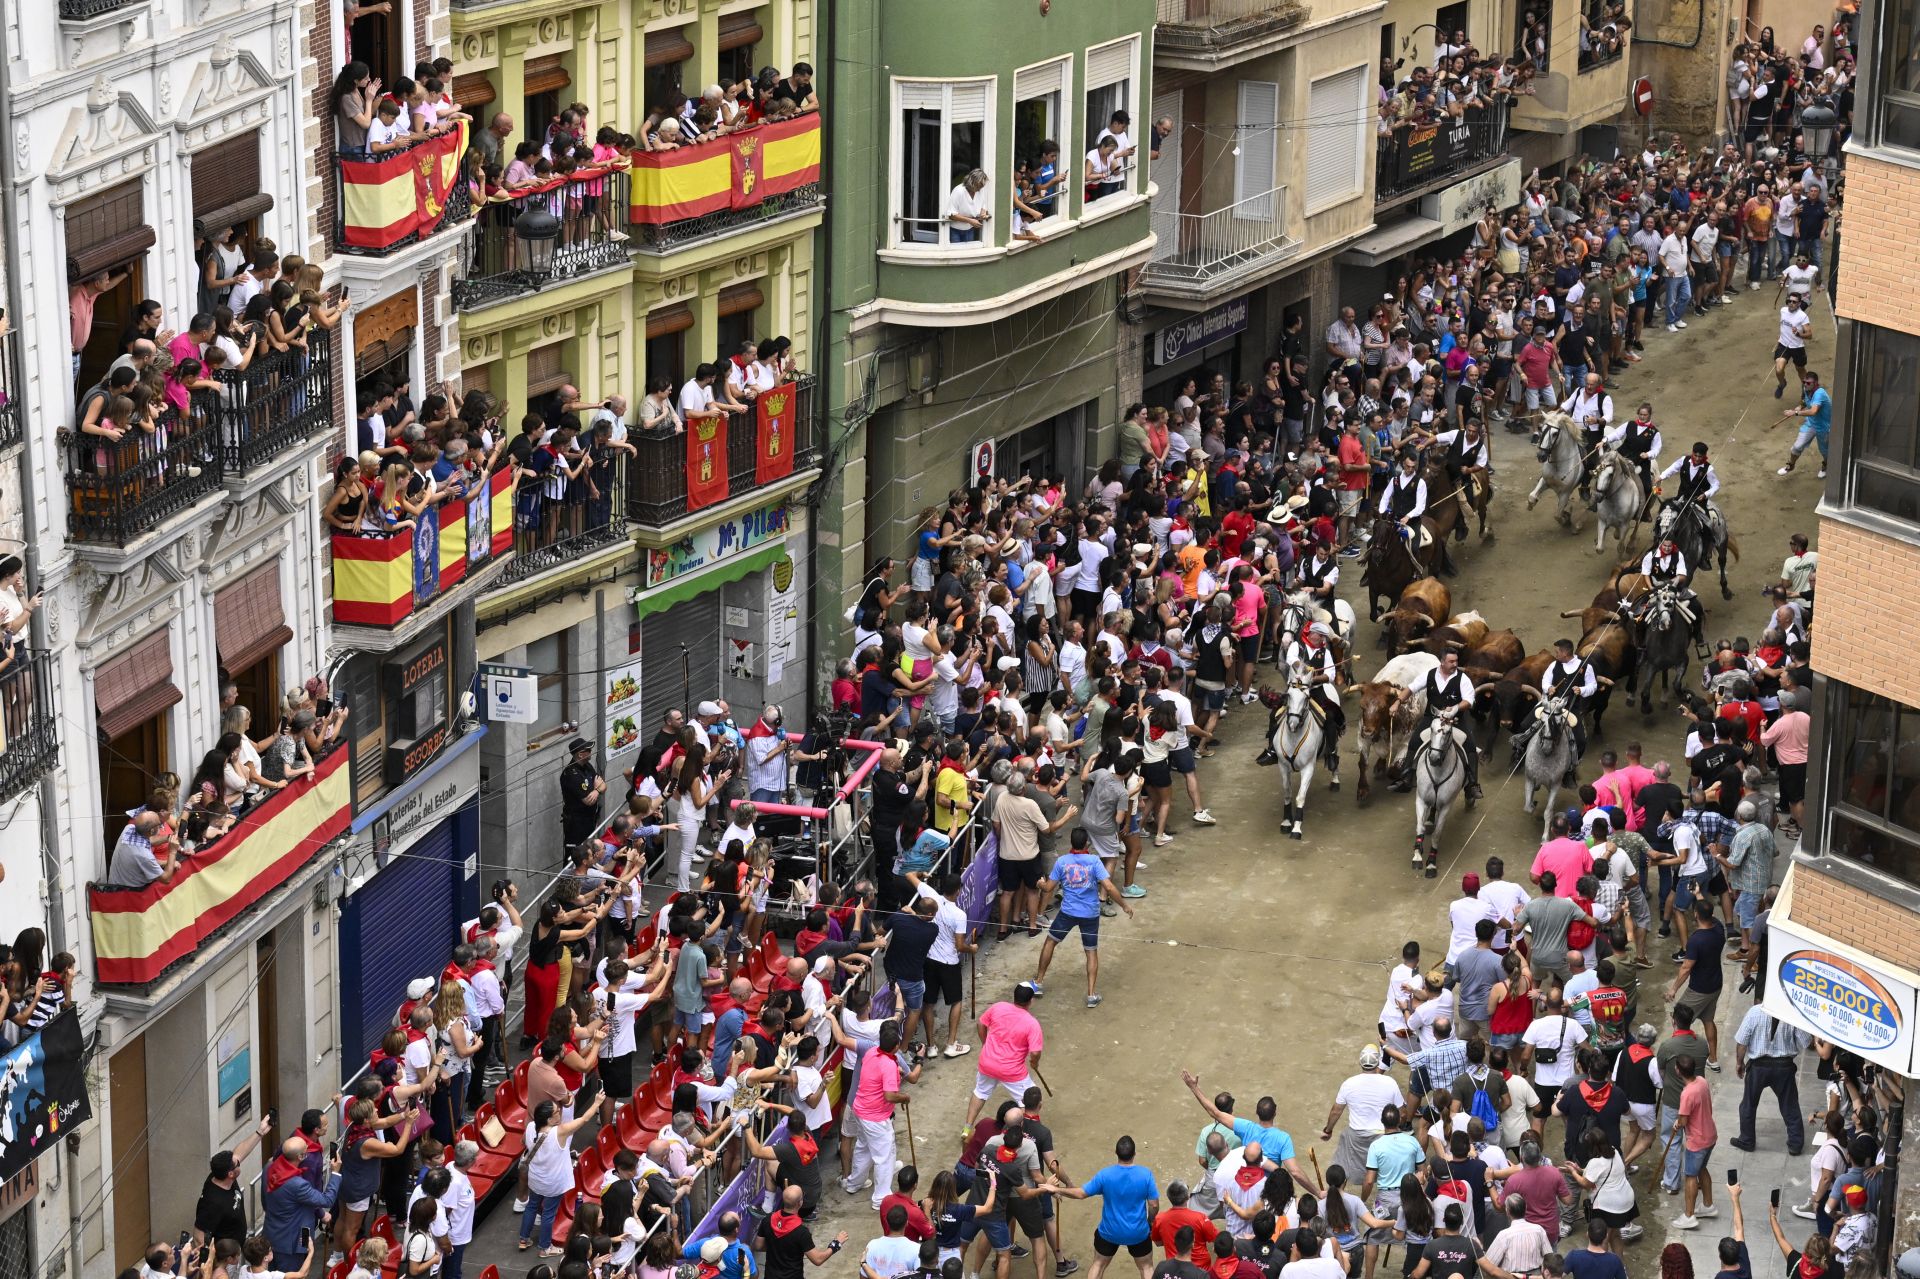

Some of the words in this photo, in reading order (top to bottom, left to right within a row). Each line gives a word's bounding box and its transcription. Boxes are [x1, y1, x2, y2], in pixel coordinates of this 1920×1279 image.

[1449, 125, 1471, 144] TURIA
[1227, 301, 1246, 328] Segorbe
[742, 507, 785, 548] Pilar
[403, 646, 445, 689] LOTERIA
[404, 729, 445, 773] SEGORBE
[391, 811, 422, 843] Apuestas
[422, 799, 433, 819] del
[434, 783, 457, 809] Estado
[418, 792, 423, 807] y
[1795, 969, 1868, 1013] 252.000
[1872, 1002, 1883, 1022] €
[1828, 1004, 1856, 1026] 50.000€
[1863, 1020, 1891, 1042] 40.000€
[0, 1166, 35, 1210] INA
